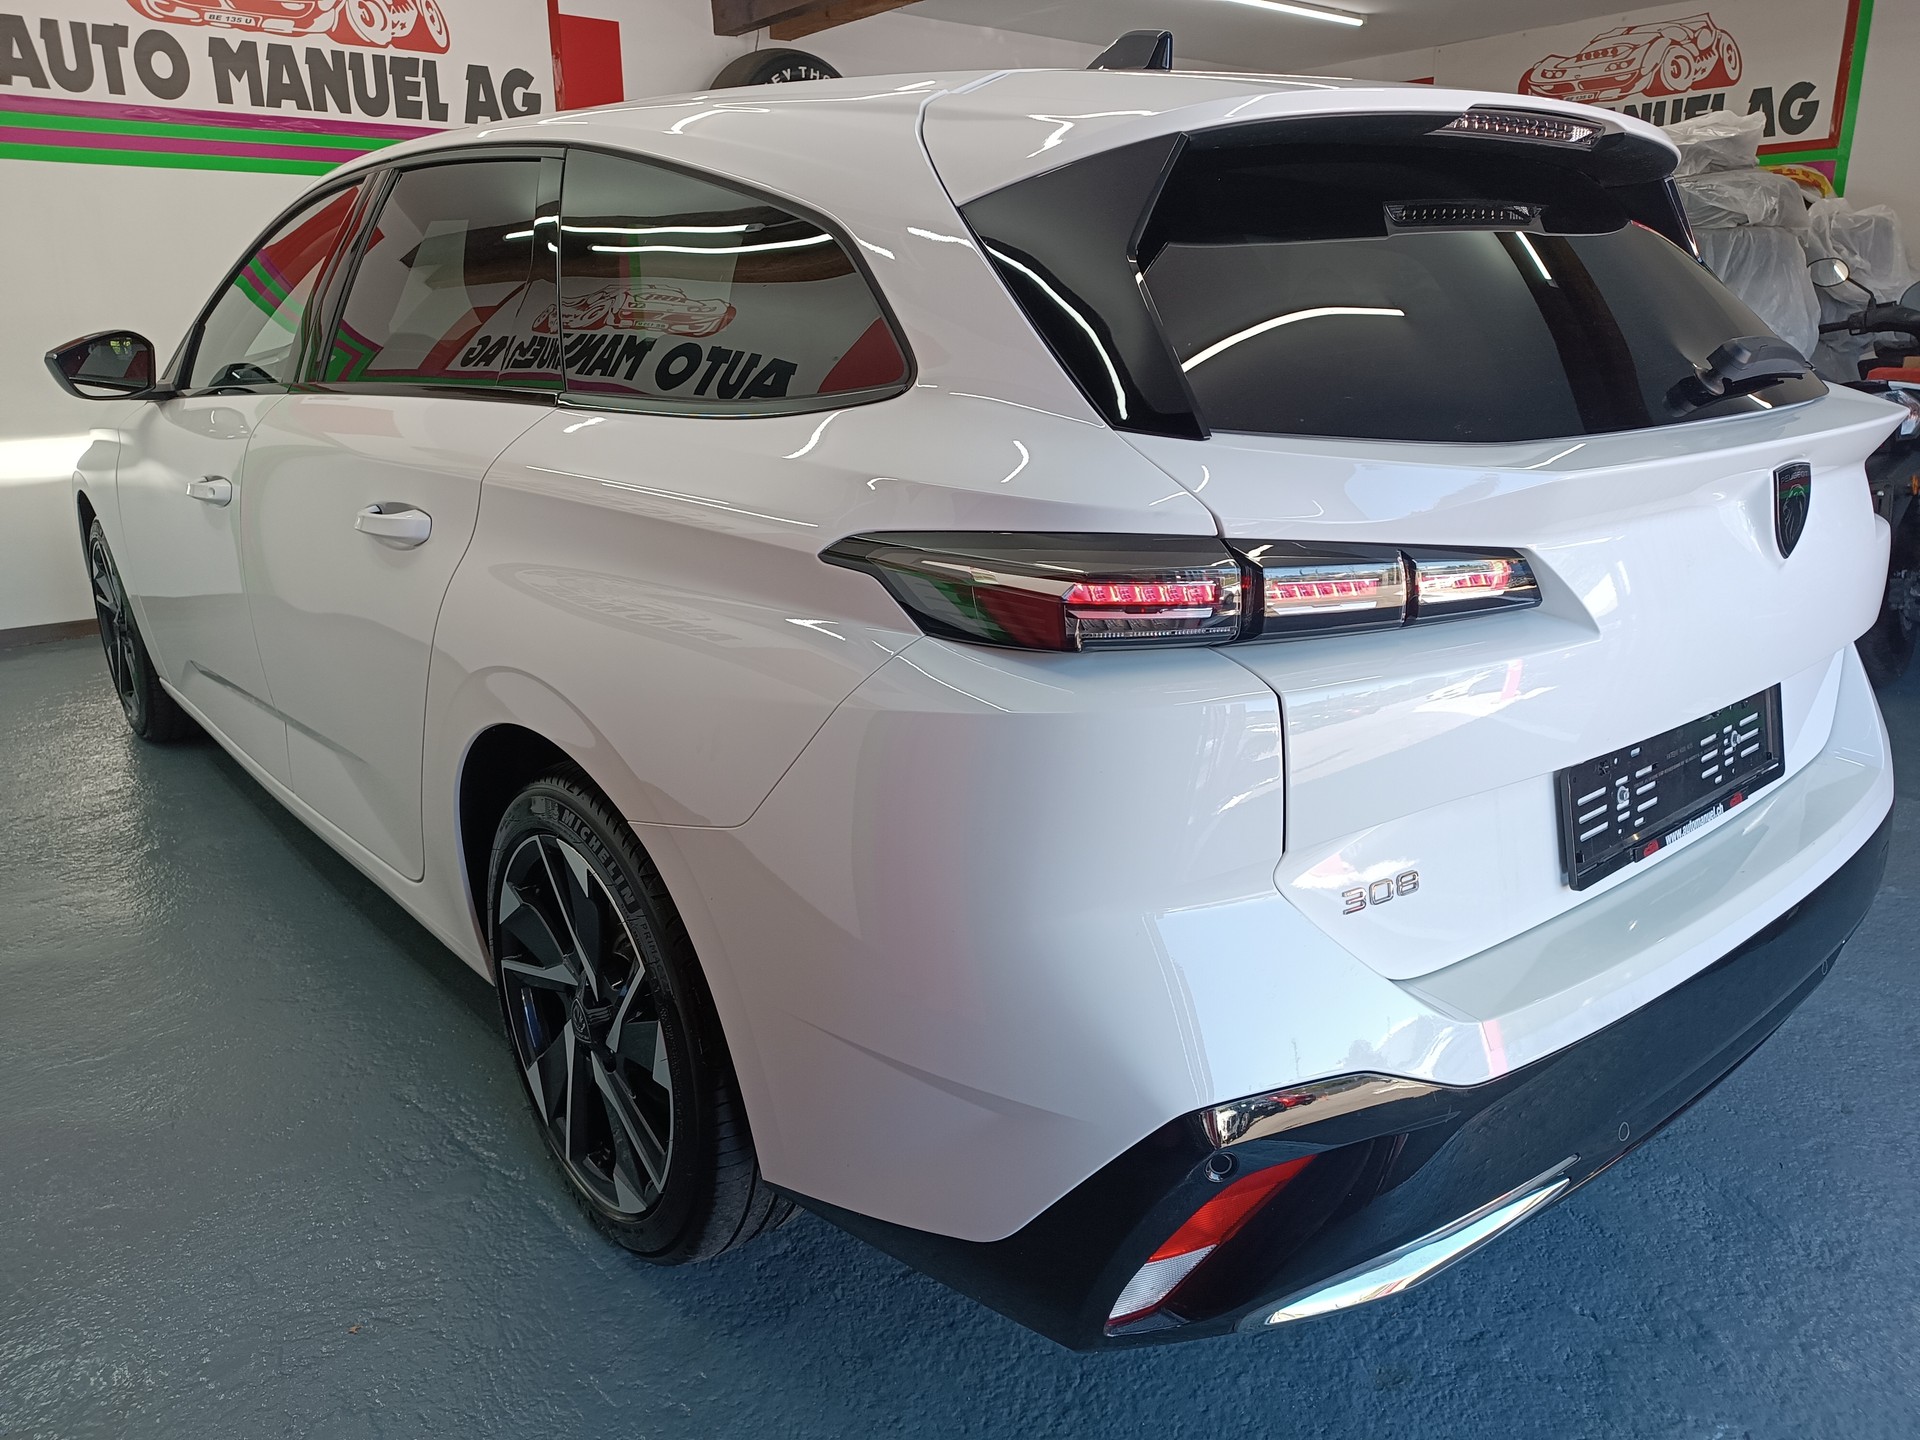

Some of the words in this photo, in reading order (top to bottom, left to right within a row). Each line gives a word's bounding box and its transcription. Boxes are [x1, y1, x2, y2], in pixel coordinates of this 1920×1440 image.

[208, 13, 223, 21] BE
[225, 15, 242, 23] 135
[0, 13, 191, 101] AUTO
[208, 36, 449, 123] MANUEL
[464, 63, 542, 125] AG
[1746, 81, 1820, 138] AG
[561, 808, 636, 905] MICHELIN
[1341, 869, 1420, 915] 308
